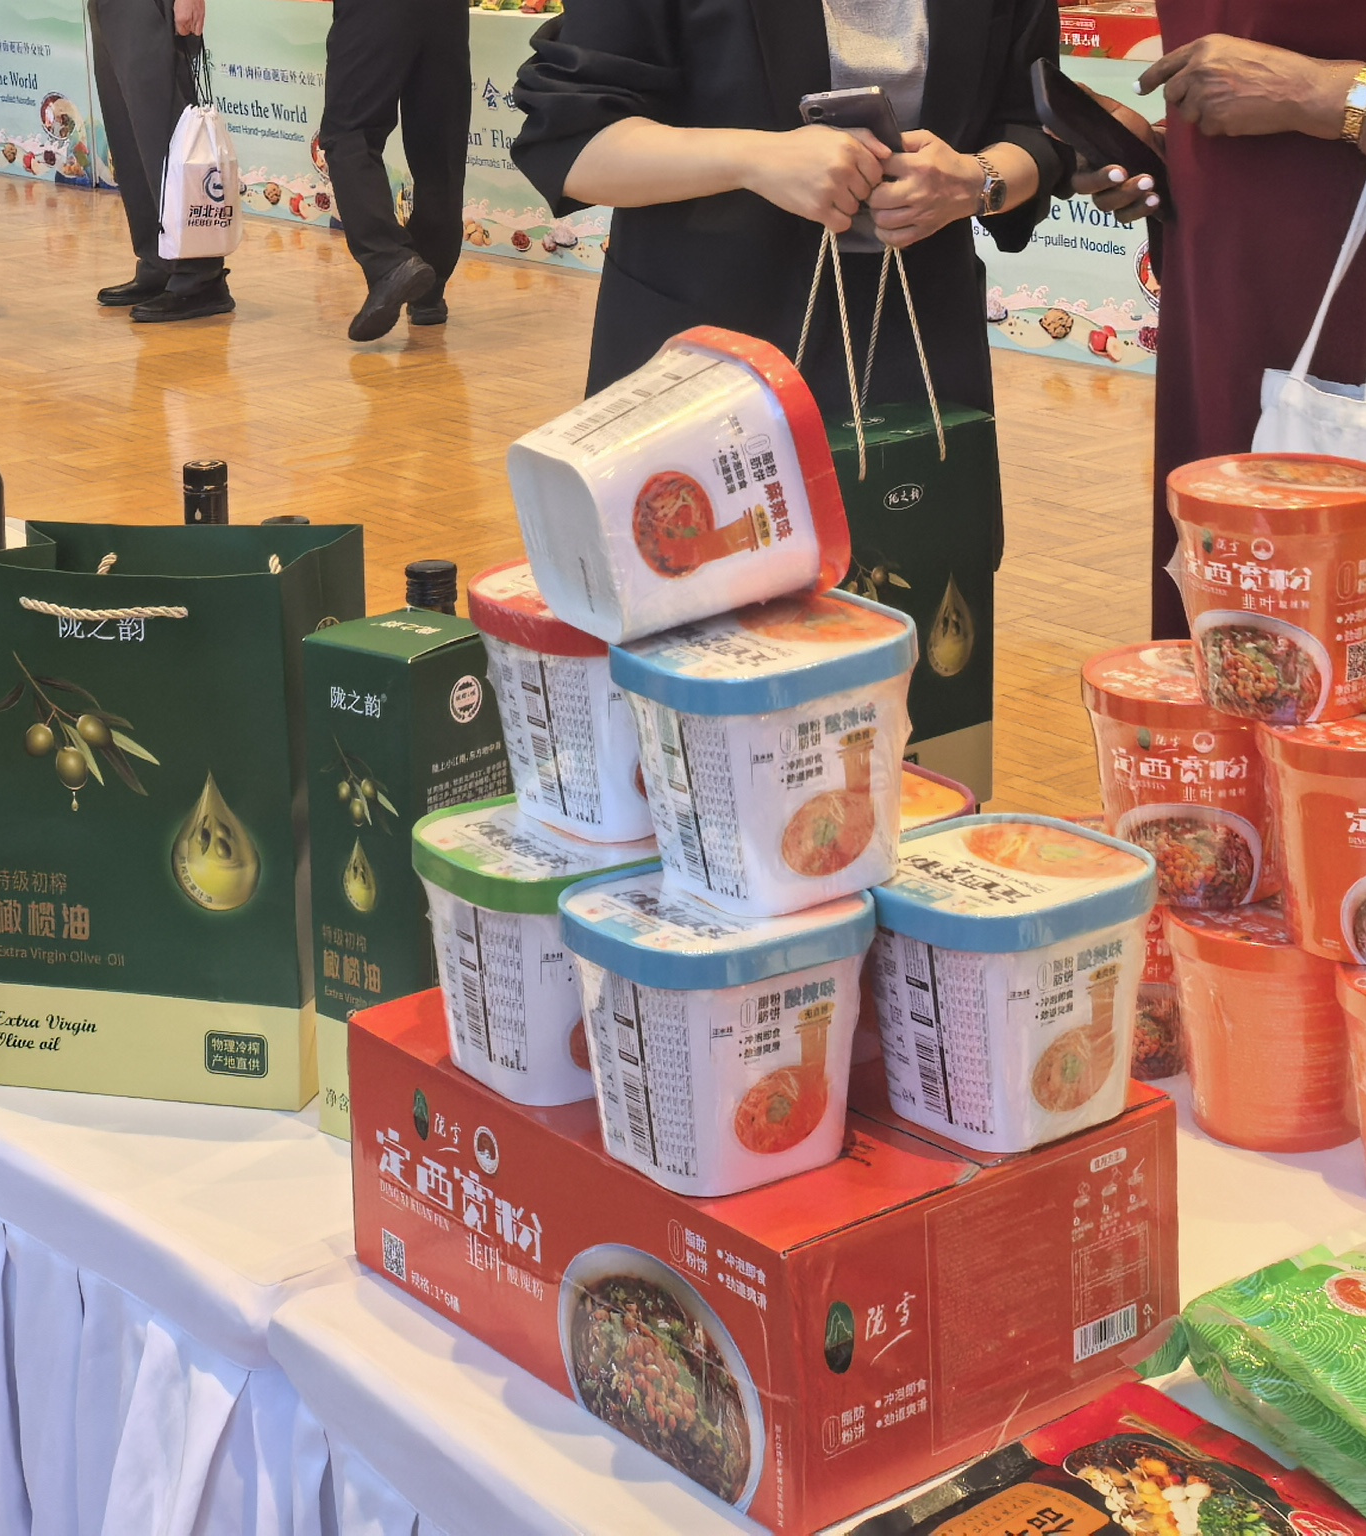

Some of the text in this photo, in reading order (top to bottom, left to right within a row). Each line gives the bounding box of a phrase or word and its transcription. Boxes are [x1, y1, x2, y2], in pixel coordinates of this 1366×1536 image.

[9, 71, 38, 90] World
[216, 97, 308, 124] Meets the World
[490, 129, 516, 149] Fla
[502, 159, 519, 171] Tas
[1031, 229, 1126, 256] d-pulled Noodles
[1187, 560, 1312, 592] 定西宽粉
[1242, 594, 1275, 612] 韭叶
[58, 615, 146, 643] 陇之韵
[330, 686, 381, 719] 陇之韵
[1111, 748, 1247, 784] 定西宽粉
[1182, 786, 1215, 802] 韭叶
[30, 948, 67, 964] Virgin
[70, 951, 102, 965] Olive
[323, 948, 381, 994] 橄榄油
[784, 978, 836, 1009] 酸辣味
[45, 1014, 98, 1037] Virgin
[39, 1037, 61, 1052] oil
[211, 1037, 260, 1056] 物理冷榨
[211, 1054, 260, 1072] 产地直供
[376, 1127, 542, 1264] 定西宽粉
[465, 1232, 508, 1282] 韭叶
